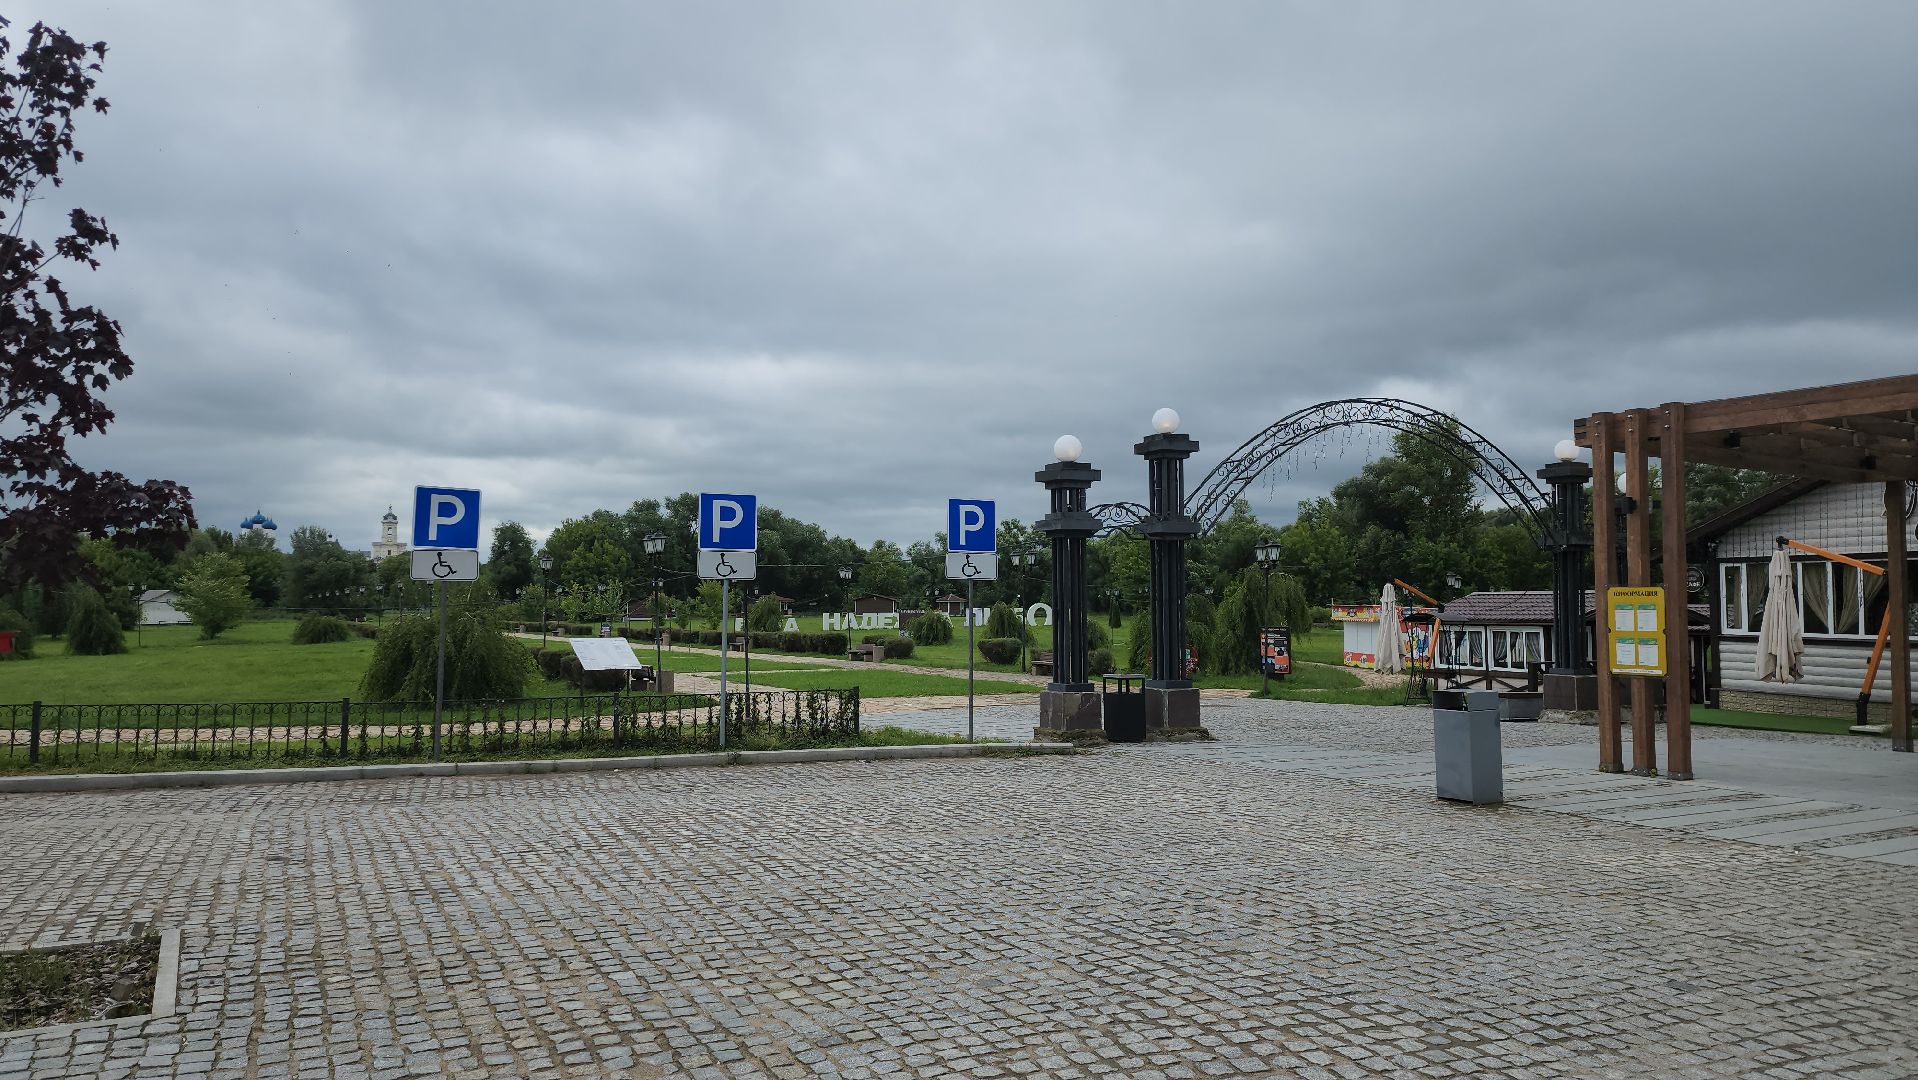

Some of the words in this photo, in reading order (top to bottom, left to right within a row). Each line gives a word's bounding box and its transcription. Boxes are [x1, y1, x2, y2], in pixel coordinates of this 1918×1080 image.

[428, 493, 466, 541] P
[712, 499, 744, 543] P
[959, 504, 985, 546] P
